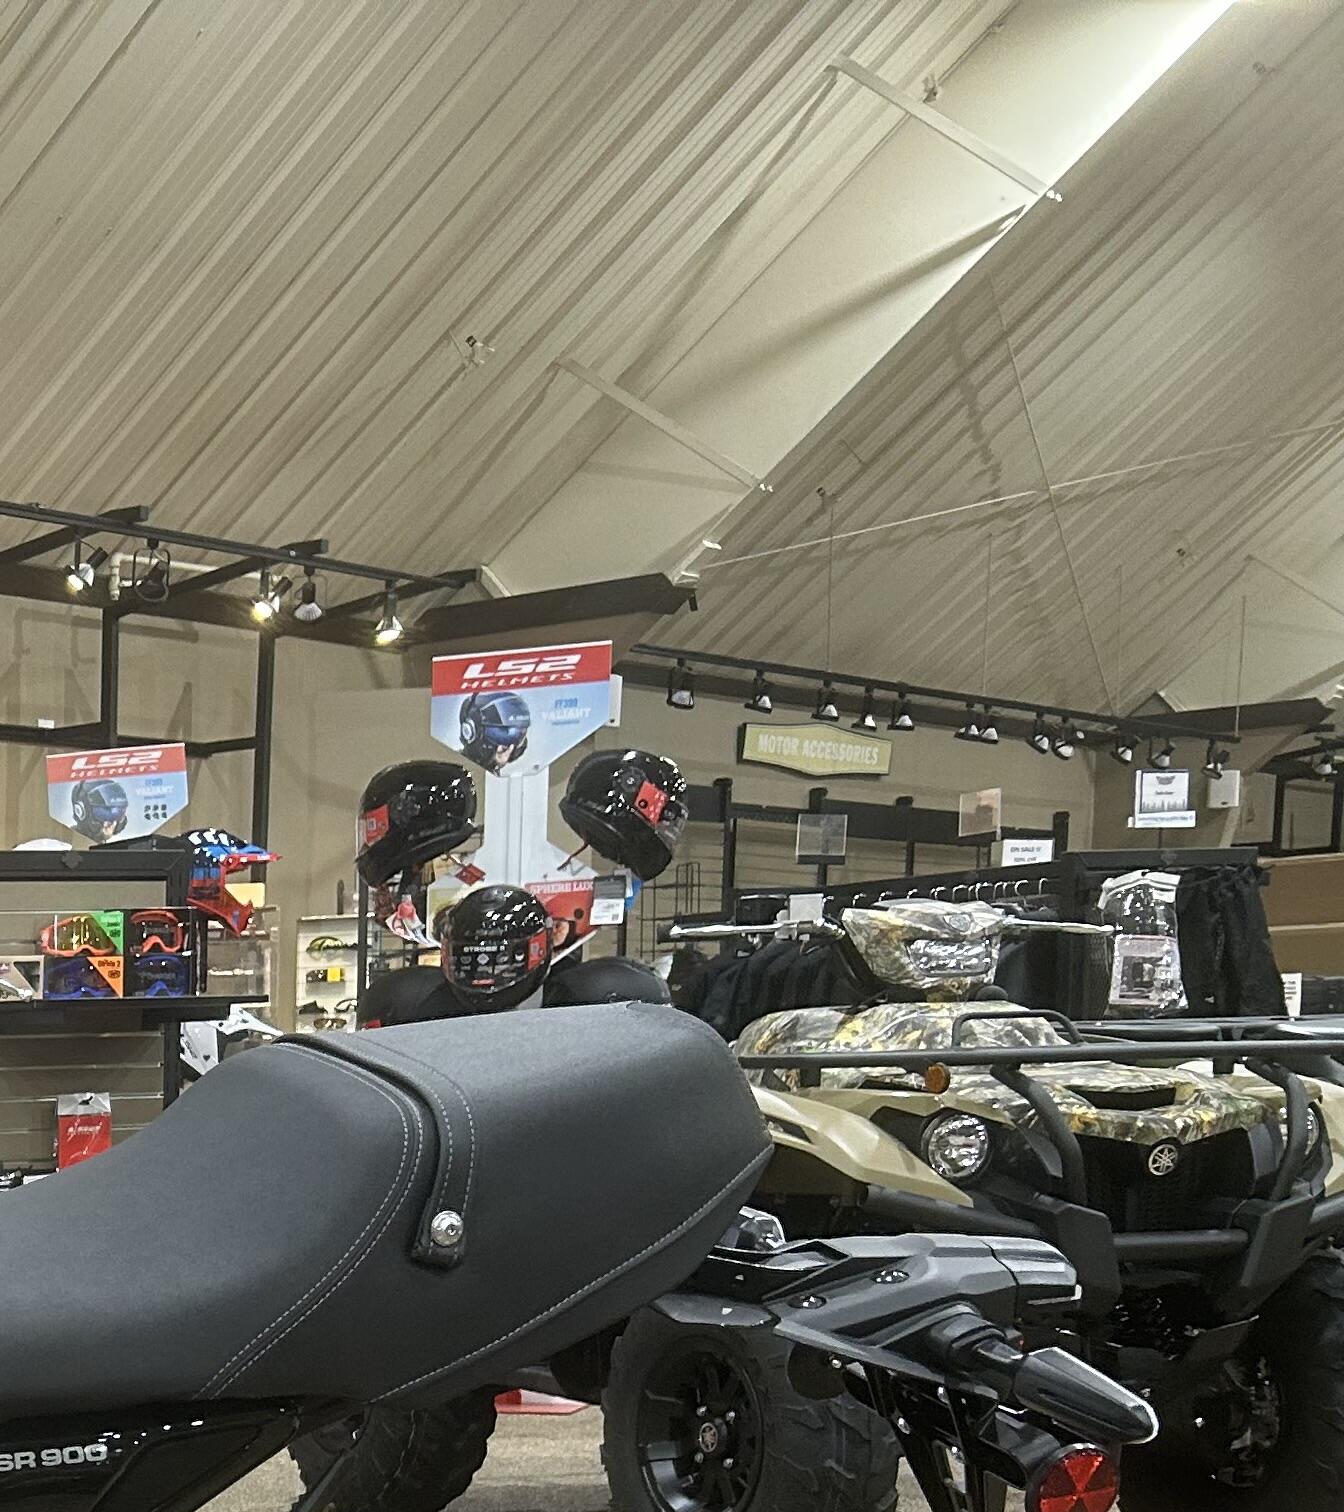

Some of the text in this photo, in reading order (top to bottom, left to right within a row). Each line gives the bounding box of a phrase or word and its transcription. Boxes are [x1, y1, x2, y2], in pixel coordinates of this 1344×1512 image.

[463, 654, 582, 680] LS2
[461, 673, 575, 689] HELMETS
[72, 750, 163, 770] LS2
[758, 733, 880, 766] MOTOR ACCESSORIES
[41, 1443, 108, 1468] 900
